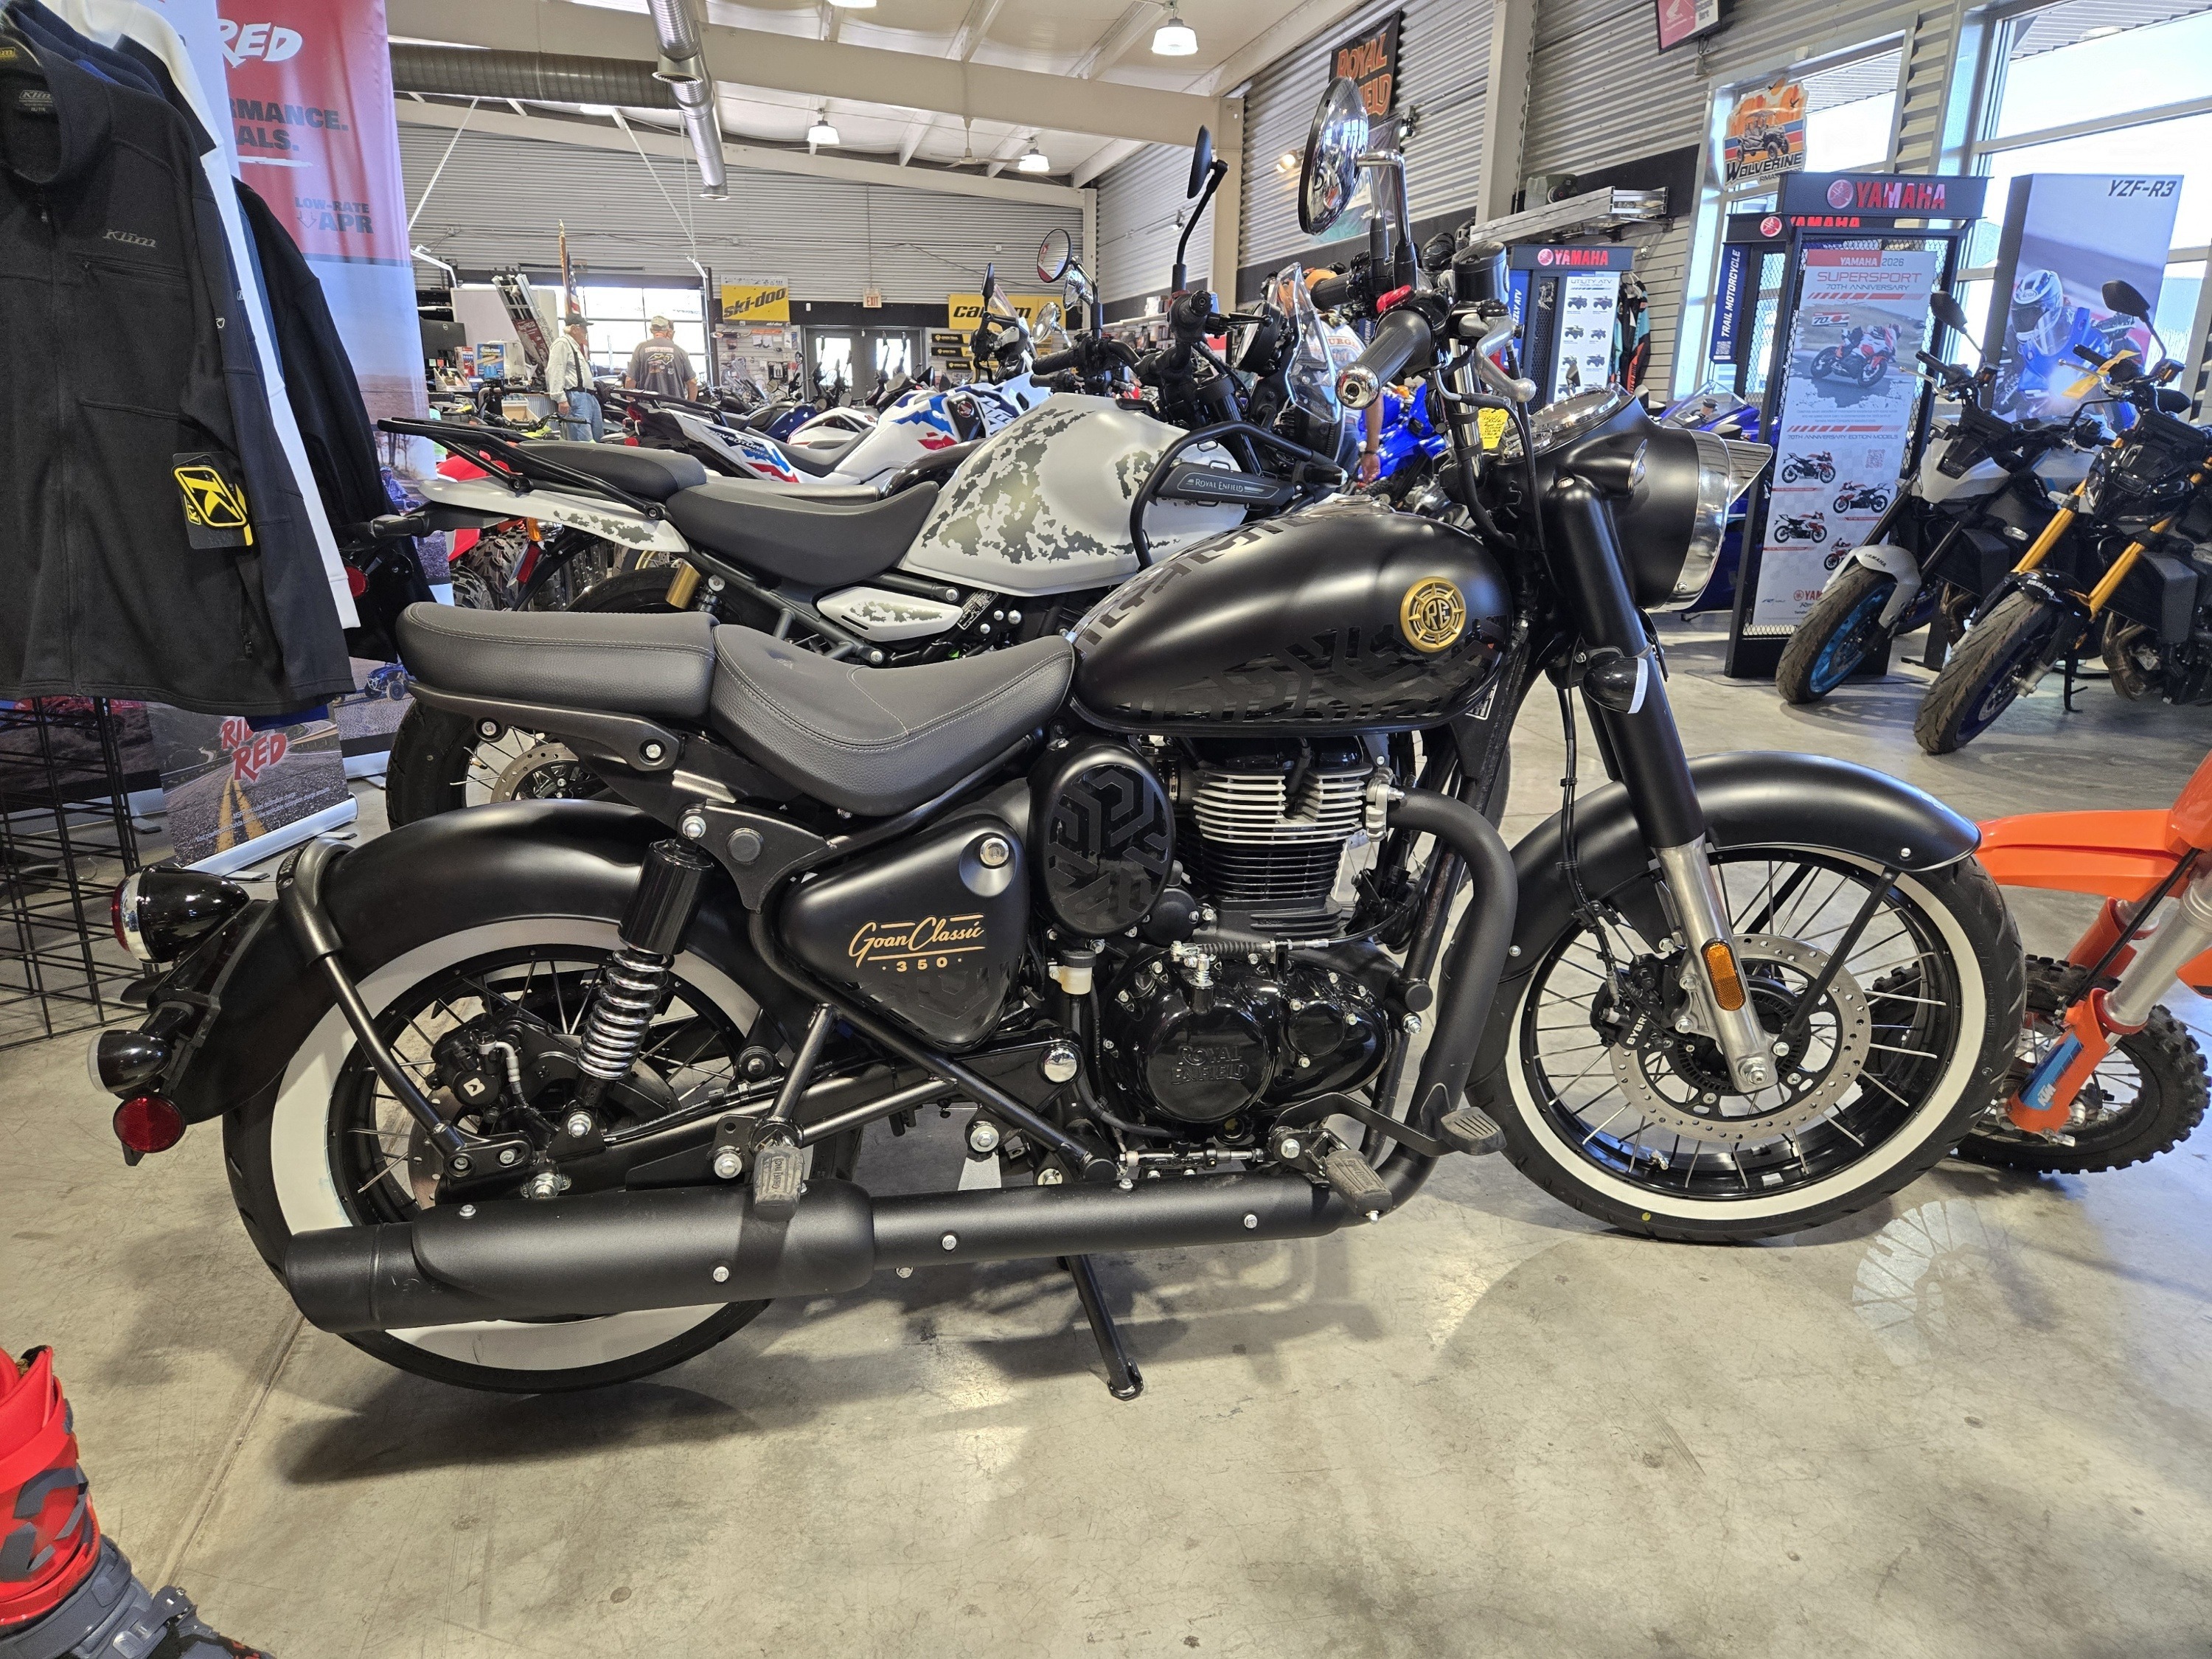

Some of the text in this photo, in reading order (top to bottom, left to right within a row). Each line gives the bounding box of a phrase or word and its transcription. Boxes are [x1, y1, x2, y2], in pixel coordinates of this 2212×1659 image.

[218, 18, 302, 68] RED
[1337, 32, 1388, 81] ROYAL
[1360, 74, 1392, 116] IELD
[237, 126, 299, 151] ALS.
[1725, 153, 1803, 182] WOLVERINE
[1856, 181, 1946, 210] YAMAHA
[2108, 180, 2177, 197] YZF-R3
[296, 197, 369, 213] LOW-RATE
[319, 213, 374, 234] APR
[1554, 249, 1609, 265] YAMAHA
[1840, 257, 1905, 267] YAMAHA 2026
[1817, 271, 1922, 282] SUPERSPORT
[723, 288, 787, 319] ski-doo
[866, 296, 879, 307] EXIT
[1514, 288, 1523, 305] ATV
[1721, 249, 1741, 337] TRAIL MOTORCYCLE
[709, 431, 766, 451] ADVENTURE
[1195, 479, 1244, 493] ROYAL ENFIELD
[1805, 590, 1823, 600] YAM
[232, 733, 287, 782] RED
[848, 917, 985, 968] Goan Classic
[1626, 1013, 1648, 1046] BYBR
[2037, 1083, 2056, 1107] KTM
